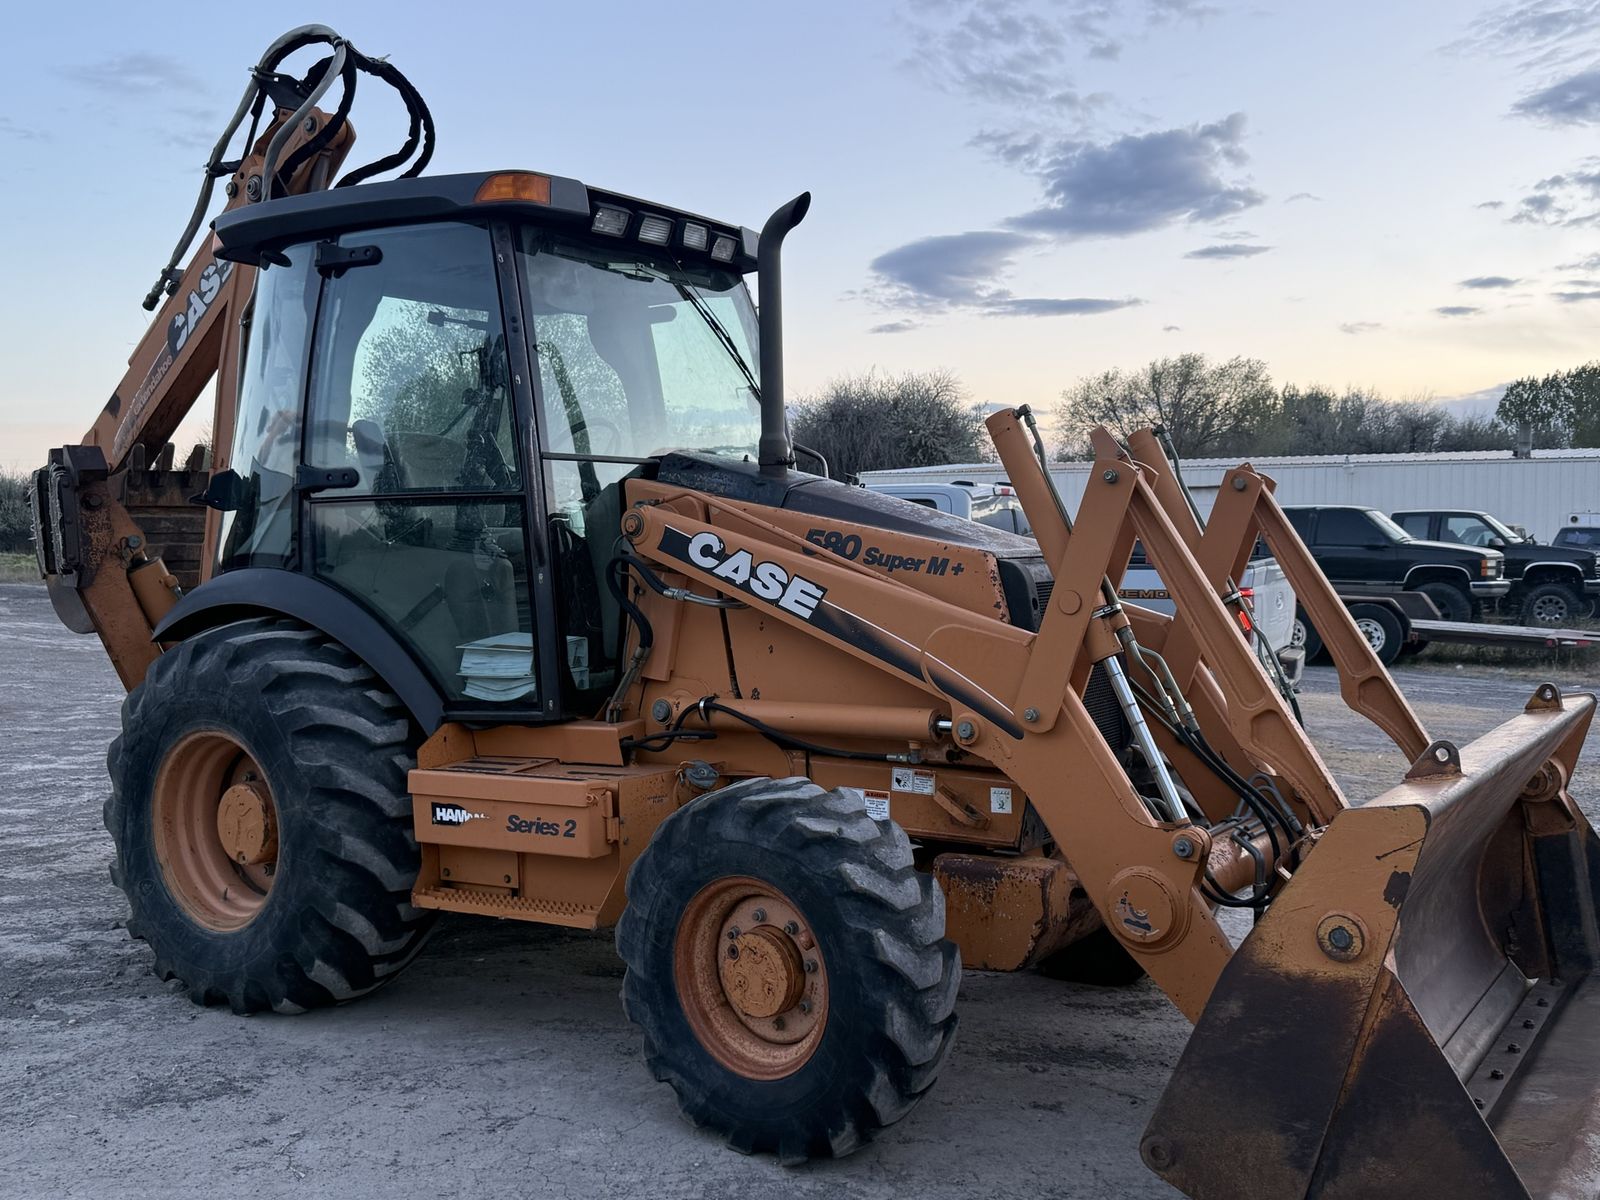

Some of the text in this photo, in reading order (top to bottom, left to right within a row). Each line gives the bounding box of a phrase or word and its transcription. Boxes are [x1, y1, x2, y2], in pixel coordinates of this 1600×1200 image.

[801, 528, 863, 561] 580
[863, 546, 926, 573] Super
[687, 532, 827, 620] CASE
[505, 815, 577, 838] Series 2
